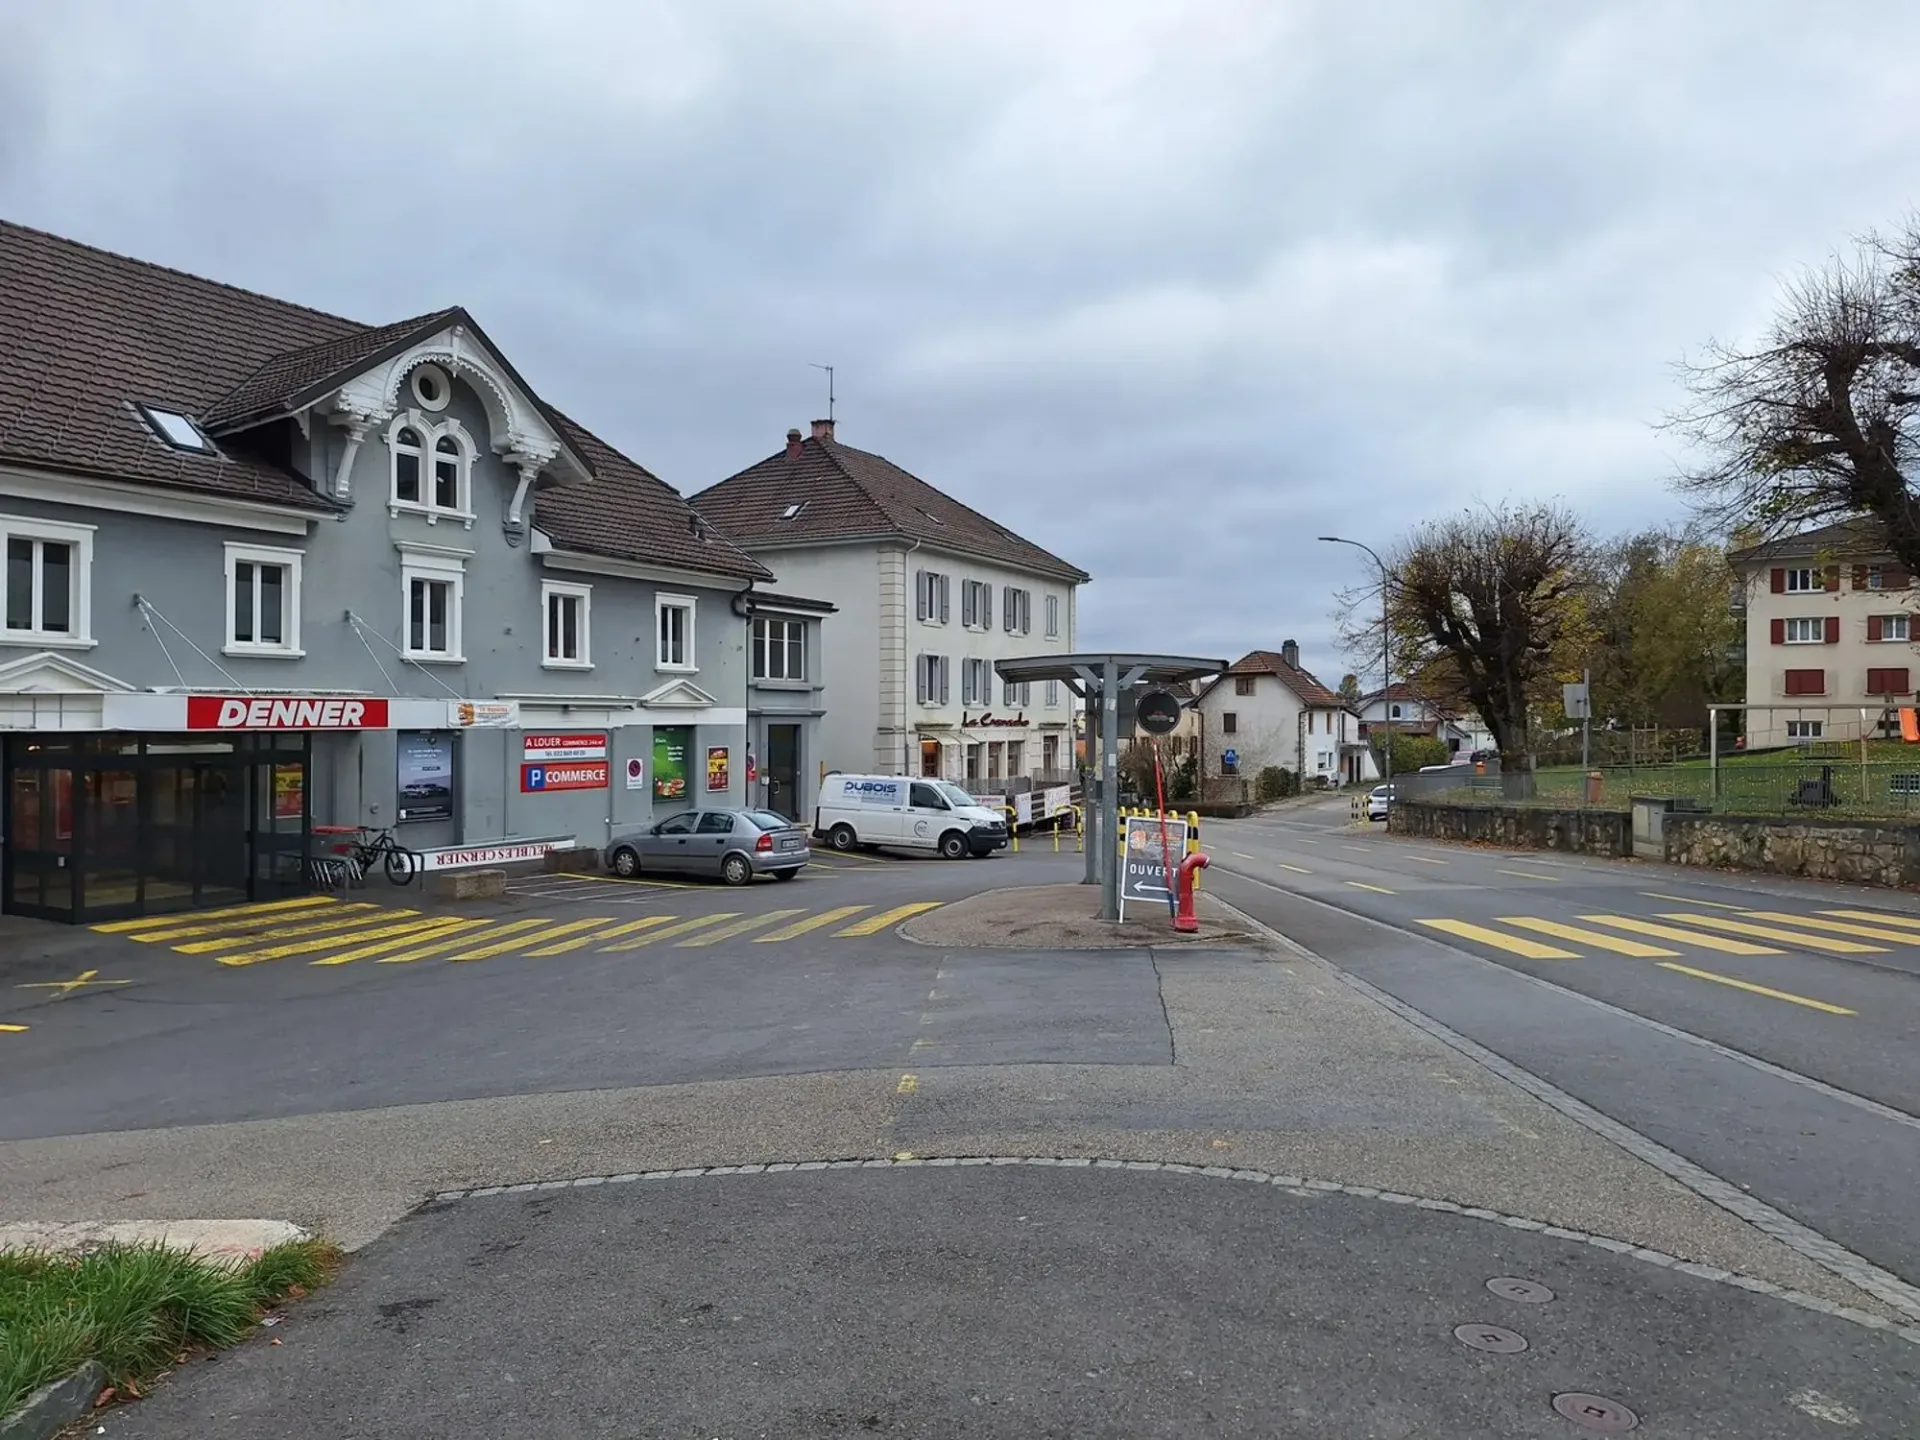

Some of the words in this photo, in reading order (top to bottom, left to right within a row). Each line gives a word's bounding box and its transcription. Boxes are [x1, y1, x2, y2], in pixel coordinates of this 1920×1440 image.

[217, 700, 366, 727] DENNER
[525, 738, 532, 747] A
[533, 737, 561, 747] LOUER
[531, 769, 541, 787] P
[545, 769, 606, 783] COMMERCE
[844, 781, 897, 793] DUBOIS
[436, 850, 496, 865] CERNIER
